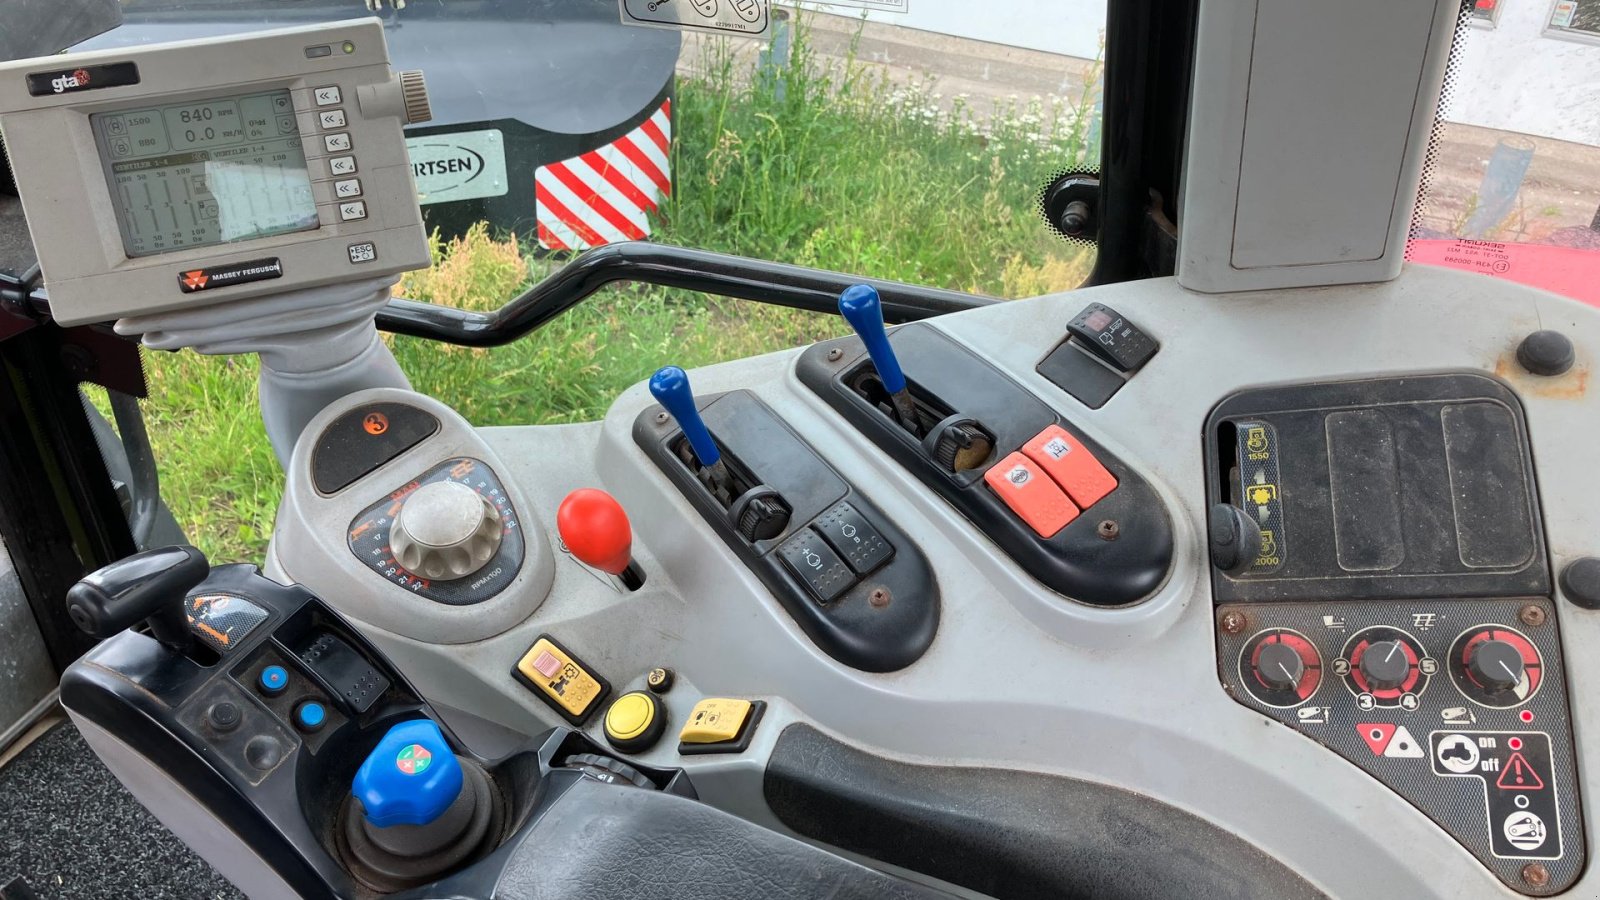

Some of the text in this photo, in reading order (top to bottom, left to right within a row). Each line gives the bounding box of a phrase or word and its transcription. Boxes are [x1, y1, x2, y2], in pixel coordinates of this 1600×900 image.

[52, 75, 79, 93] gta
[180, 107, 213, 123] 840
[128, 117, 151, 127] 1500
[185, 127, 215, 143] 0.0
[411, 157, 472, 177] RTSEN
[354, 244, 372, 254] ESC
[211, 263, 280, 281] MASSEY FERGUSON
[1248, 452, 1270, 460] 1550
[495, 496, 507, 504] 20
[506, 520, 517, 529] 22
[373, 533, 382, 541] 17
[372, 548, 382, 556] 18
[376, 560, 386, 568] 19
[1255, 556, 1280, 566] 2000
[385, 567, 396, 577] 20
[398, 575, 408, 584] 21
[412, 581, 423, 591] 22
[1478, 736, 1497, 749] on
[1481, 757, 1500, 772] off
